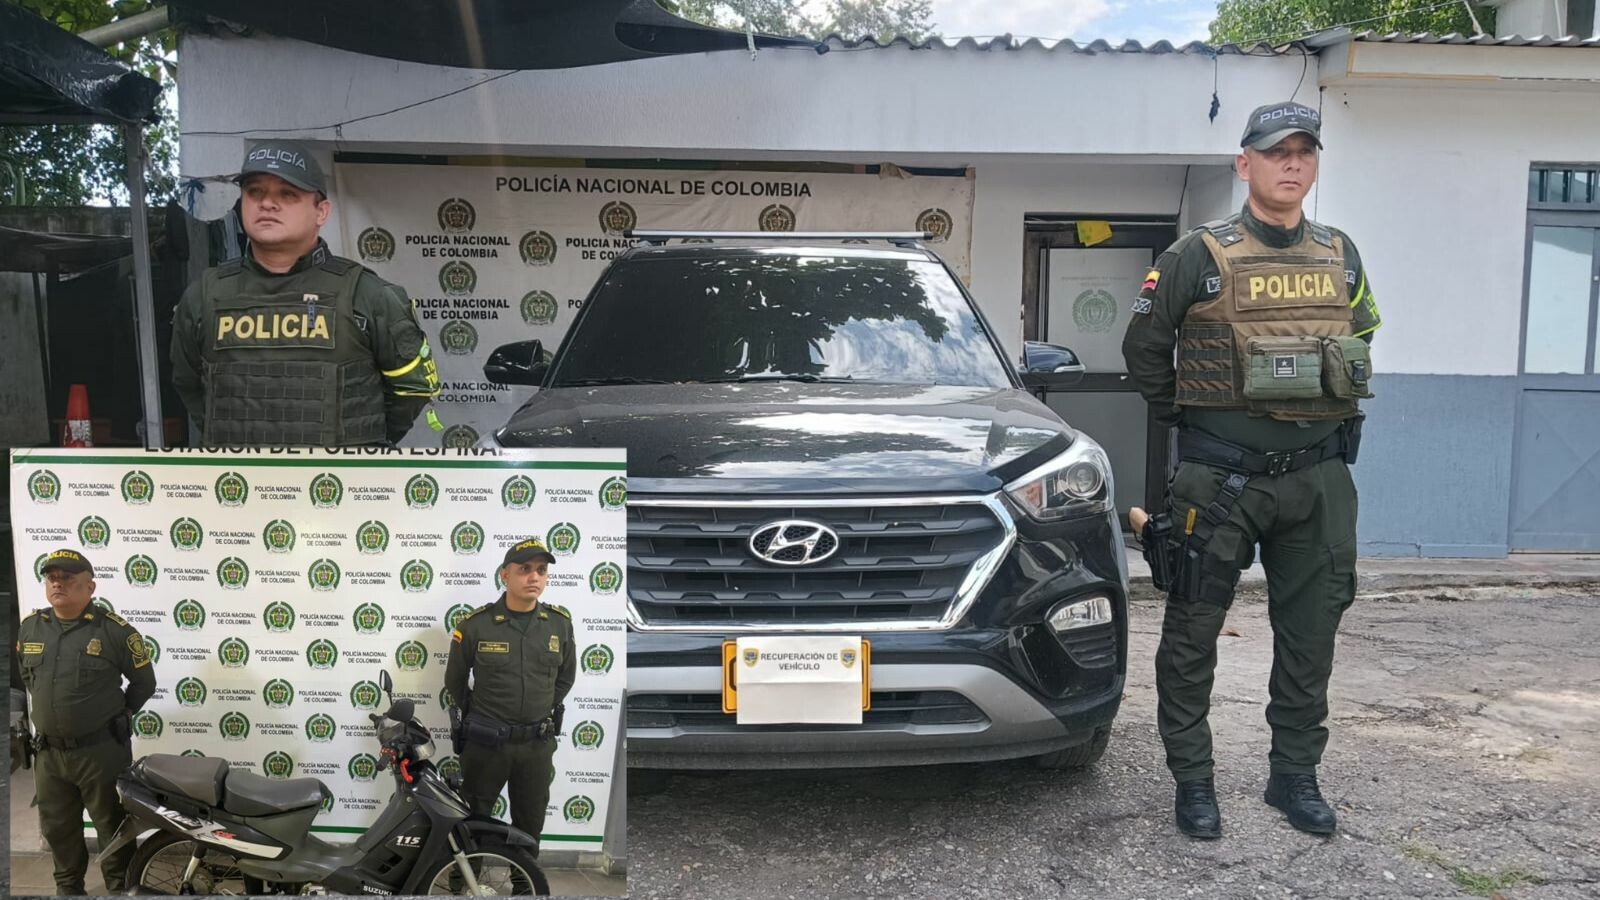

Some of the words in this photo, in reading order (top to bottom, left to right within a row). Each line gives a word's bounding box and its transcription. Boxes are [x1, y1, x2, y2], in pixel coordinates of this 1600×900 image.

[496, 174, 571, 193] POLICÍA
[577, 178, 675, 195] NACIONAL
[681, 180, 705, 195] DE
[711, 181, 812, 197] COLOMBIA
[405, 235, 450, 245] POLICIA
[454, 236, 511, 246] NACIONAL
[422, 248, 437, 258] DE
[440, 248, 498, 258] COLOMBIA
[582, 250, 596, 260] DE
[1249, 273, 1337, 300] POLICIA
[415, 299, 450, 308] OLICIA
[454, 299, 510, 309] NACIONAL
[423, 310, 437, 320] DE
[441, 310, 498, 320] COLOMBIA
[217, 313, 329, 340] POLICIA
[452, 382, 512, 391] NACIONAL
[438, 394, 497, 403] COLOMBIA
[261, 492, 268, 500] DE
[354, 493, 361, 501] DE
[761, 651, 825, 660] RECUPERACIÓN
[779, 662, 820, 671] VEHÍCULO
[396, 835, 421, 845] 115
[363, 885, 392, 896] SUZUKI
